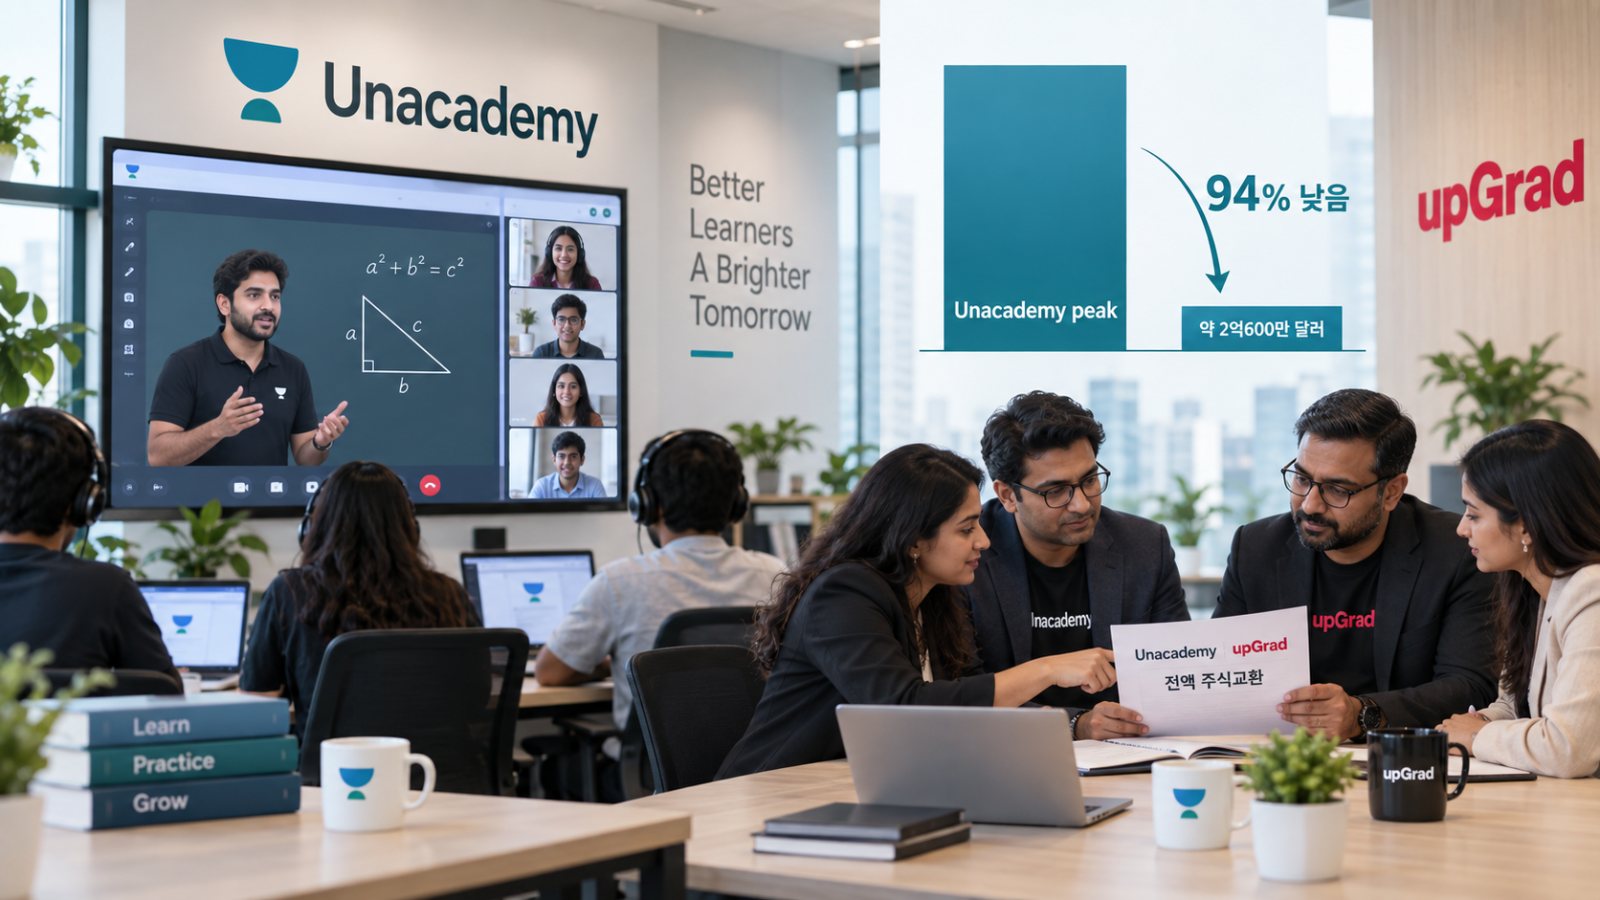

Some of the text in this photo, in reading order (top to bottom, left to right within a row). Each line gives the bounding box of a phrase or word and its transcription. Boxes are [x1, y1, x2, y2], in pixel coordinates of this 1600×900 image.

[324, 61, 598, 158] Unacademy
[690, 163, 765, 202] Better
[1418, 138, 1584, 242] upGrad
[690, 207, 794, 248] Learners
[690, 251, 811, 295] A Brighter
[689, 294, 812, 332] Tomorrow
[345, 328, 357, 341] a
[412, 320, 422, 333] c
[399, 376, 409, 394] b
[1312, 609, 1376, 633] upGrad
[1135, 637, 1288, 661] Unacademy upGrad
[1164, 669, 1264, 691] 전액 주식교환
[133, 717, 191, 737] Learn
[133, 752, 216, 775] Practice
[1383, 766, 1435, 783] upGrad
[132, 793, 189, 813] Grow
